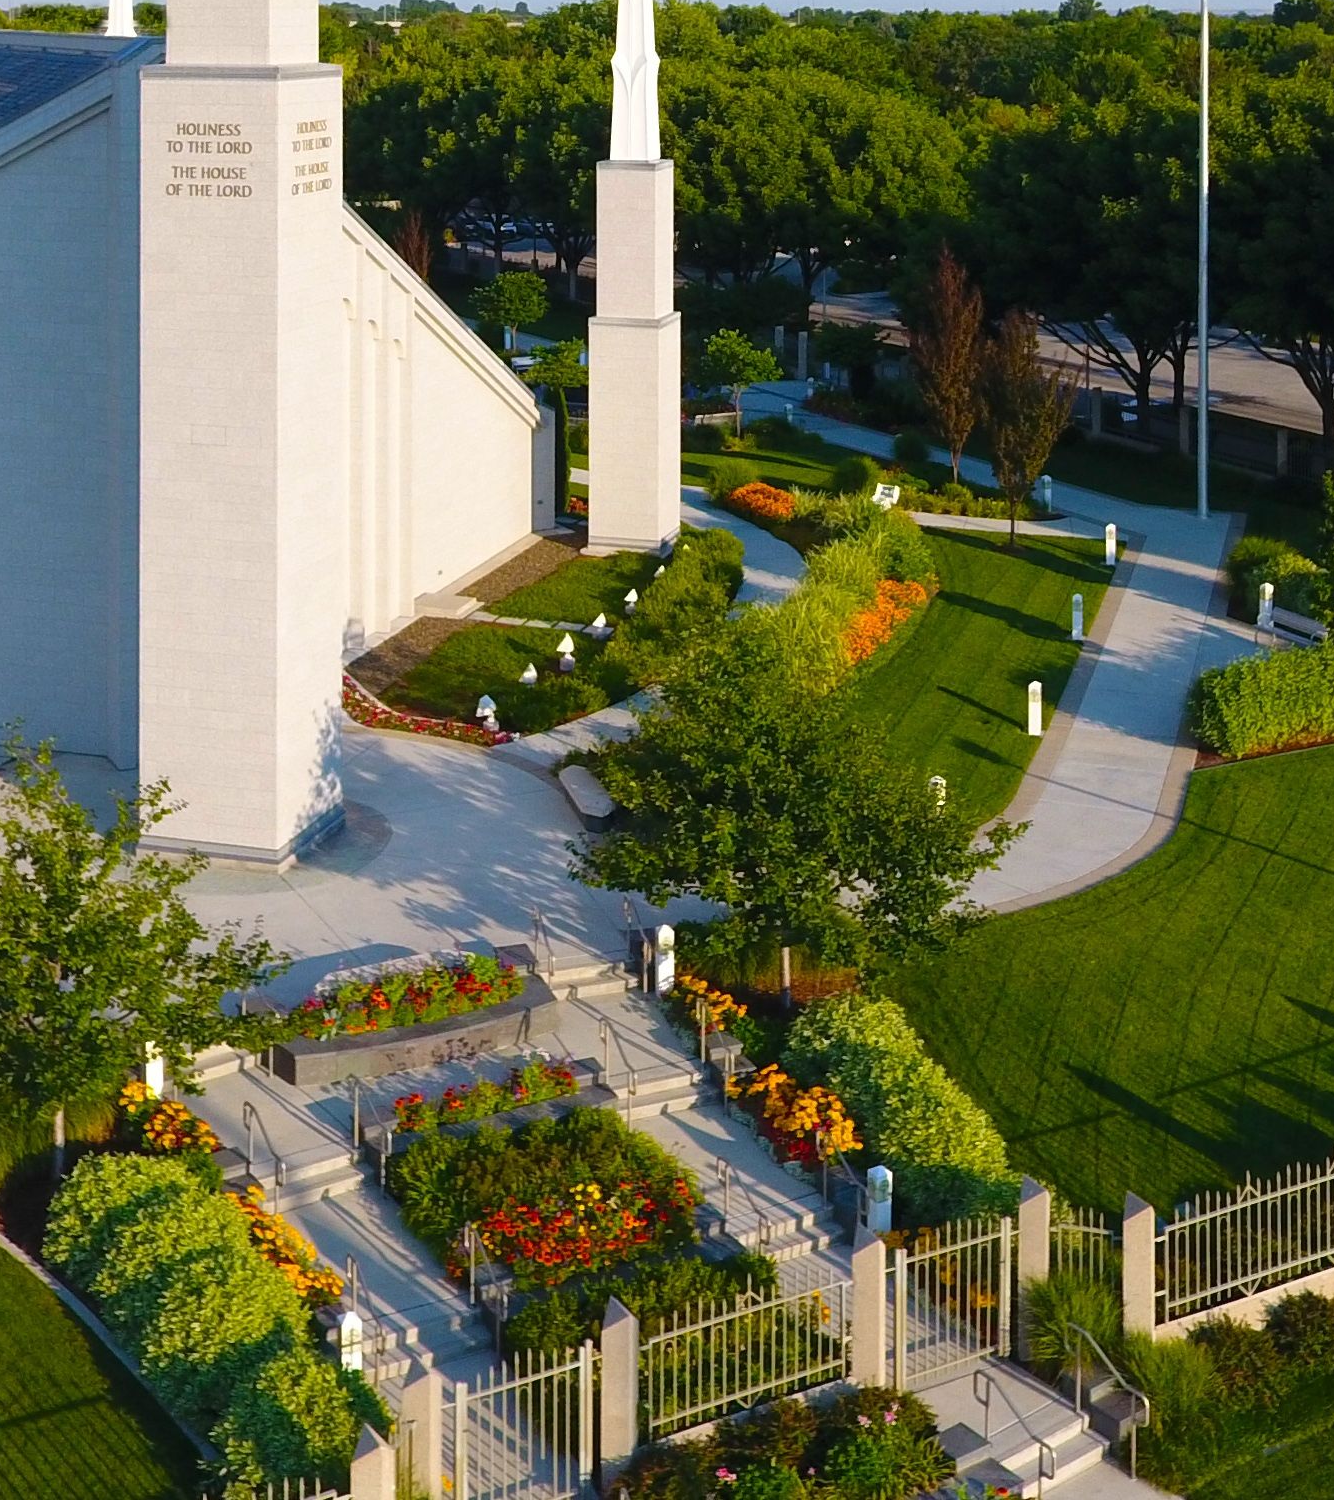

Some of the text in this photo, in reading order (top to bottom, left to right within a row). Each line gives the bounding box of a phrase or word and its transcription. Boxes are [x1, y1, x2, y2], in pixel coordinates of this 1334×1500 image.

[176, 123, 241, 136] HOLINESS
[297, 120, 327, 134] HOLINESS
[166, 141, 252, 154] TO THE LORD
[292, 136, 332, 152] TO THE LORD
[172, 166, 247, 180] THE HOUSE
[295, 161, 329, 177] THE HOUSE
[166, 183, 252, 197] OF THE LORD
[291, 178, 332, 195] OF THE LORD
